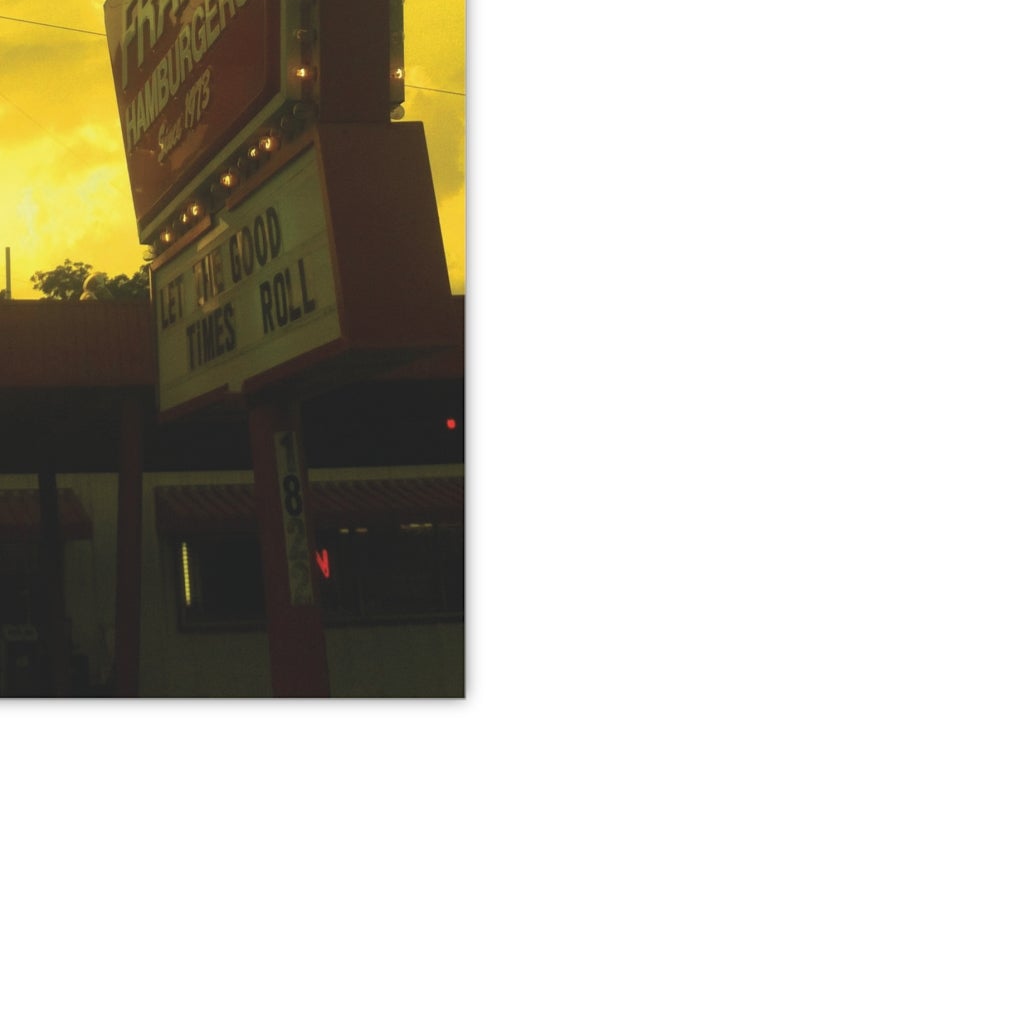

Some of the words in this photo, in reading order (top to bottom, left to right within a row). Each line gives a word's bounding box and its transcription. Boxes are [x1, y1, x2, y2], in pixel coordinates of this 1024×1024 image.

[157, 116, 183, 163] Since
[184, 68, 211, 129] 1973
[159, 273, 184, 330] LET
[192, 245, 225, 304] THE
[228, 206, 283, 284] GOOD
[259, 258, 317, 335] ROLL
